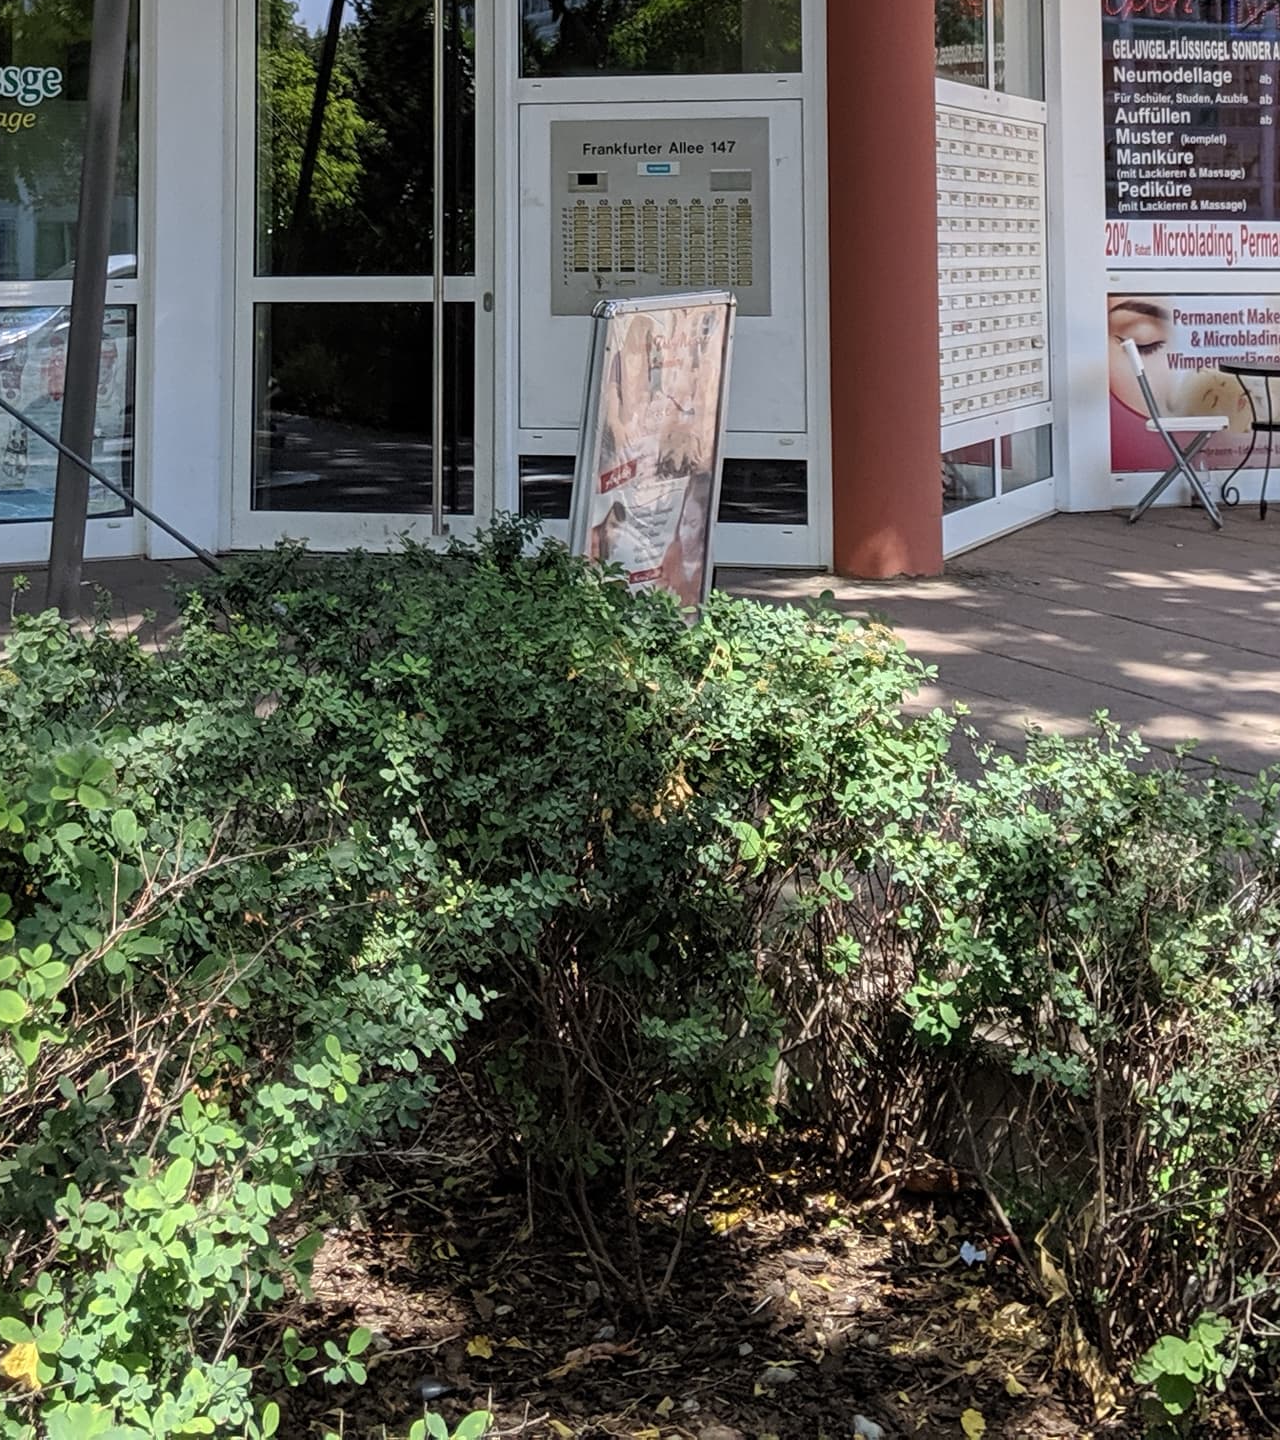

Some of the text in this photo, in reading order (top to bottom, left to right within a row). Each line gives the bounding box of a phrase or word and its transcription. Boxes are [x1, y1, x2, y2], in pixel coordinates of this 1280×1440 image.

[1113, 36, 1230, 61] GEL-UVGEL-FLÜSSIGGEL
[1232, 41, 1272, 61] SONDER
[1113, 66, 1232, 87] Neumodellage
[1259, 74, 1272, 85] ab
[1114, 93, 1272, 105] Für Schüler, Studen, Azubis ab
[1115, 107, 1191, 124] Auffüllen
[1260, 114, 1272, 125] ab
[1116, 128, 1174, 145] Muster
[1180, 133, 1227, 146] (komplet)
[583, 141, 736, 156] Frankfurter Allee 147
[1116, 148, 1193, 165] Maniküre
[1116, 168, 1246, 180] (mit Lackieren & Massage)
[1118, 181, 1192, 198] Pediküre
[1118, 200, 1247, 213] (mit Lackieren & Massage)
[1105, 222, 1132, 256] 20%
[1153, 222, 1238, 266] Microblading,
[1173, 308, 1244, 326] Permanent
[1190, 330, 1200, 348] &
